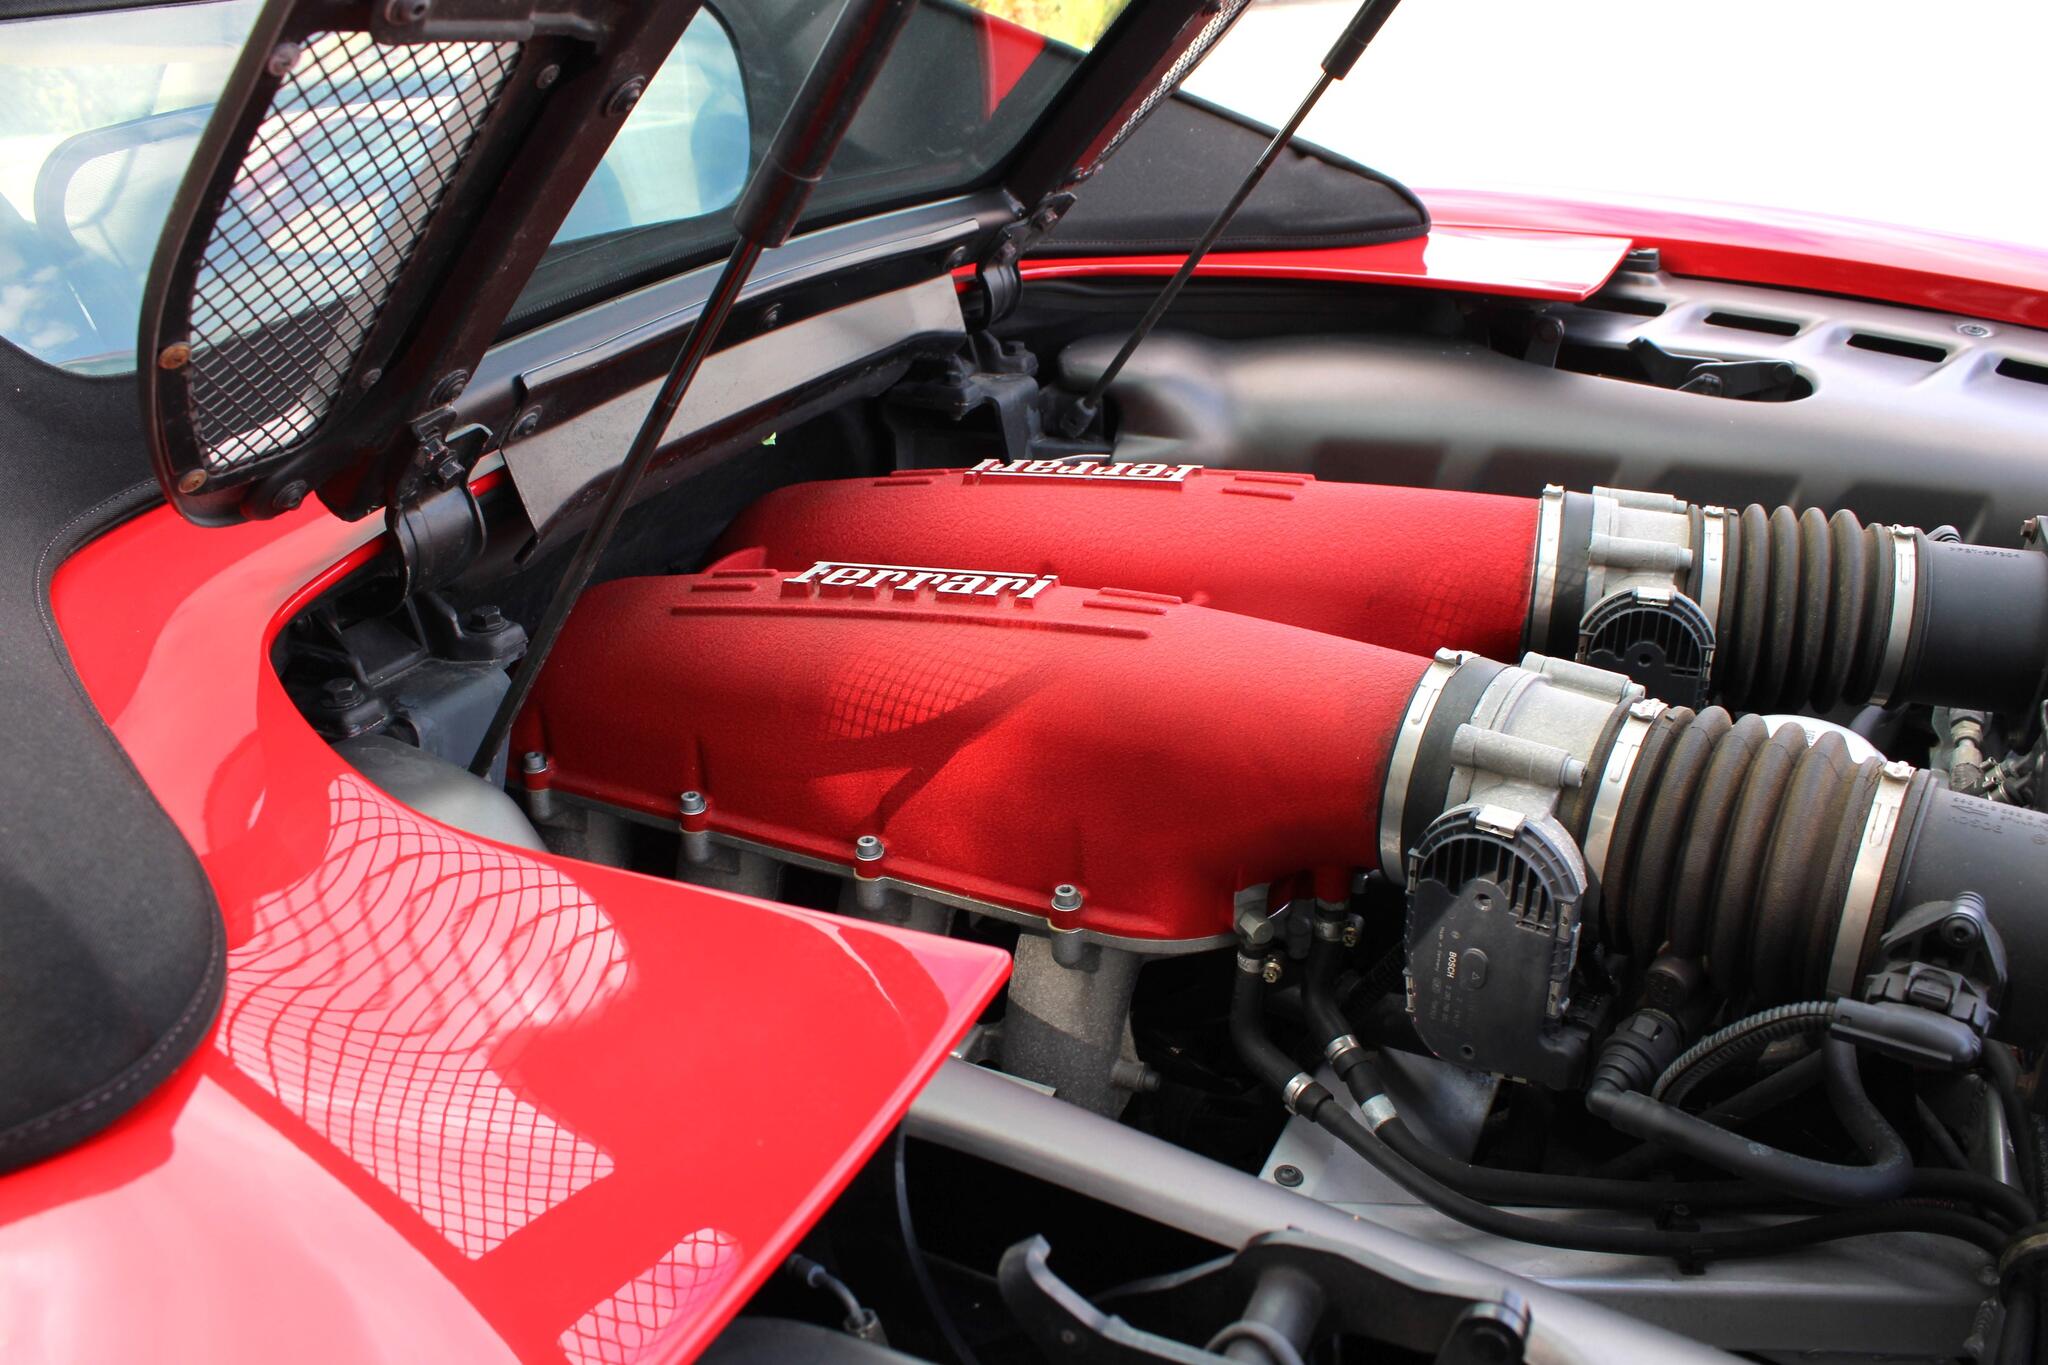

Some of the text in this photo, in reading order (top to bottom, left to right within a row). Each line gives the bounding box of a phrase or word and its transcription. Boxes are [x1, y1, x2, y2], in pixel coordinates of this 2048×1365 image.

[964, 459, 1204, 482] Ferrari
[783, 561, 1058, 600] Ferrari
[1447, 951, 1457, 978] BOSCH
